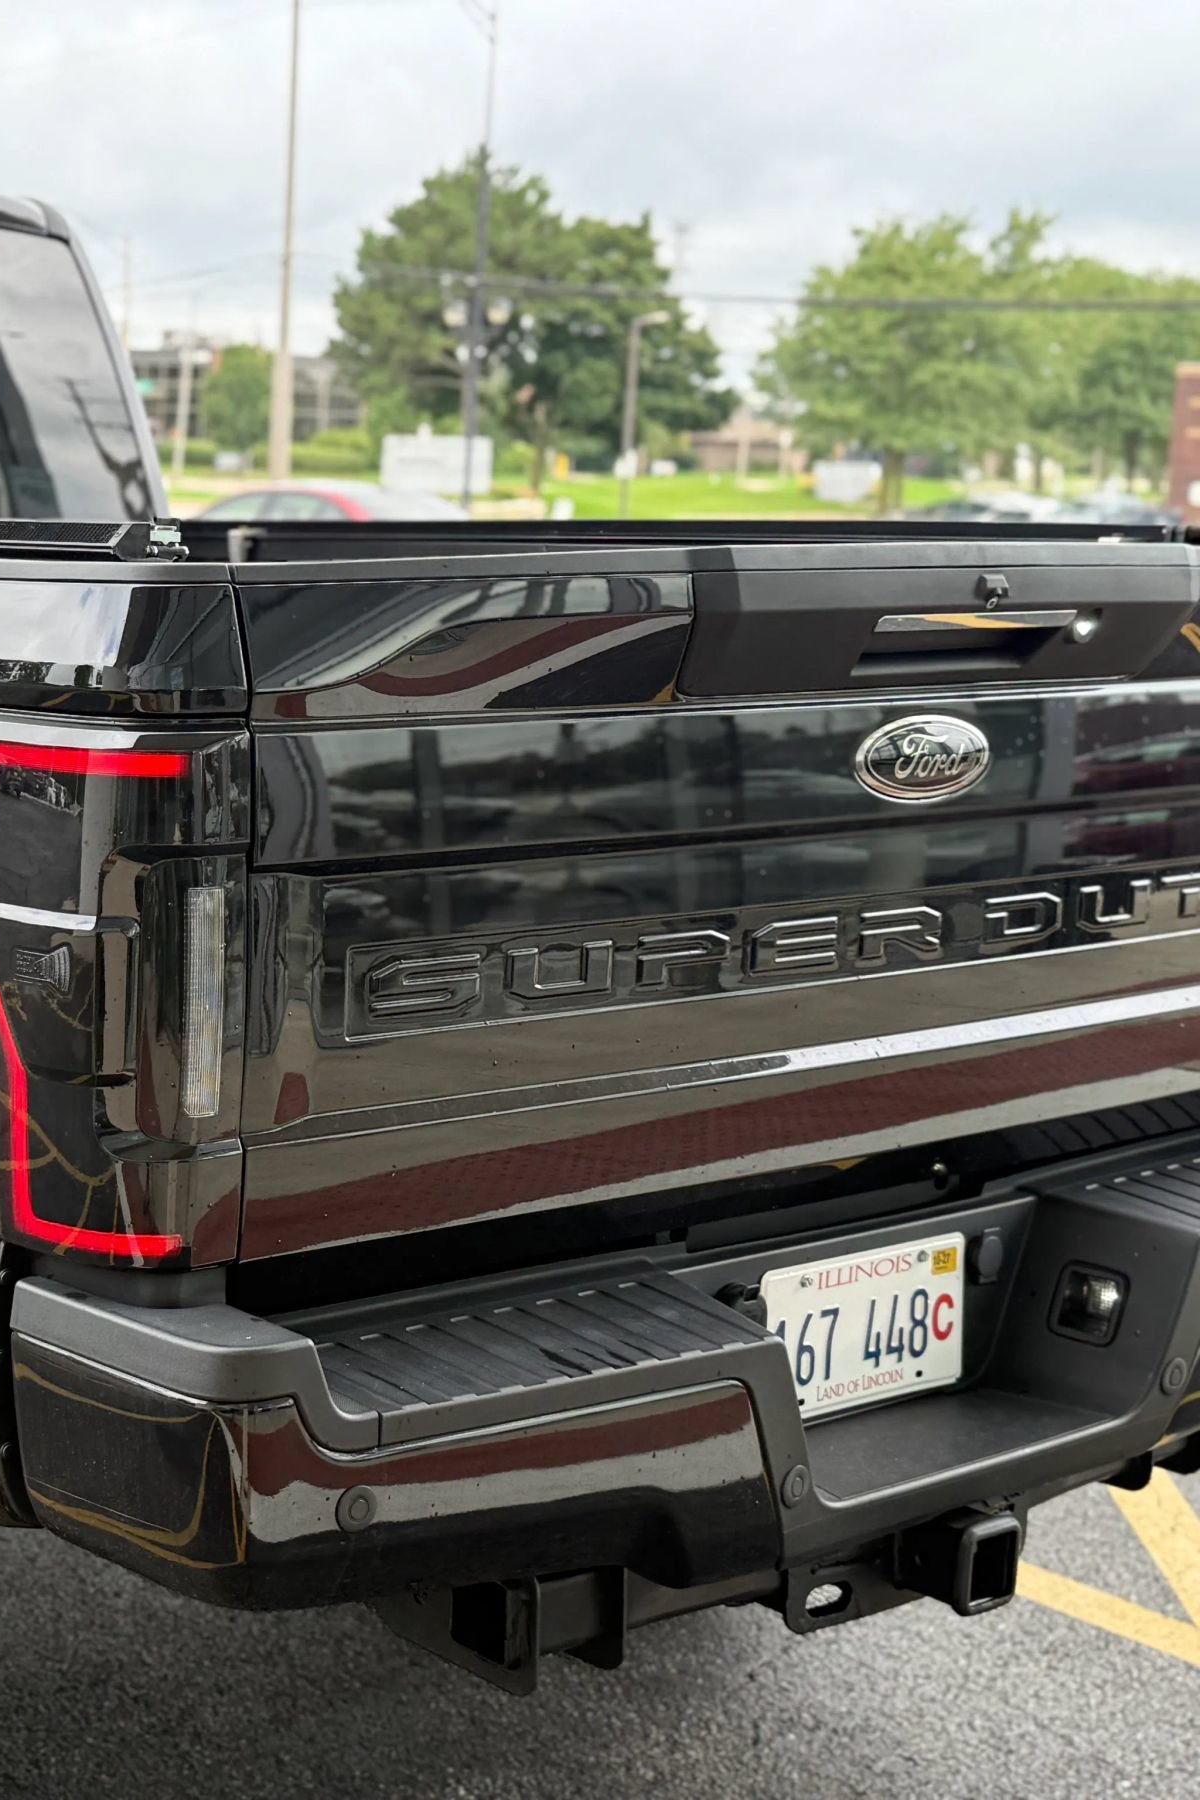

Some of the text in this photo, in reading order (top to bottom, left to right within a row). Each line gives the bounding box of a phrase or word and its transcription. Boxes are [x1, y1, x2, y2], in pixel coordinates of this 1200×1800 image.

[895, 733, 966, 779] Ford
[367, 905, 943, 1020] SUPER
[817, 1253, 913, 1290] ILLINOIS
[774, 1306, 841, 1386] 67
[816, 1368, 904, 1402] LAND OF LINCOLN
